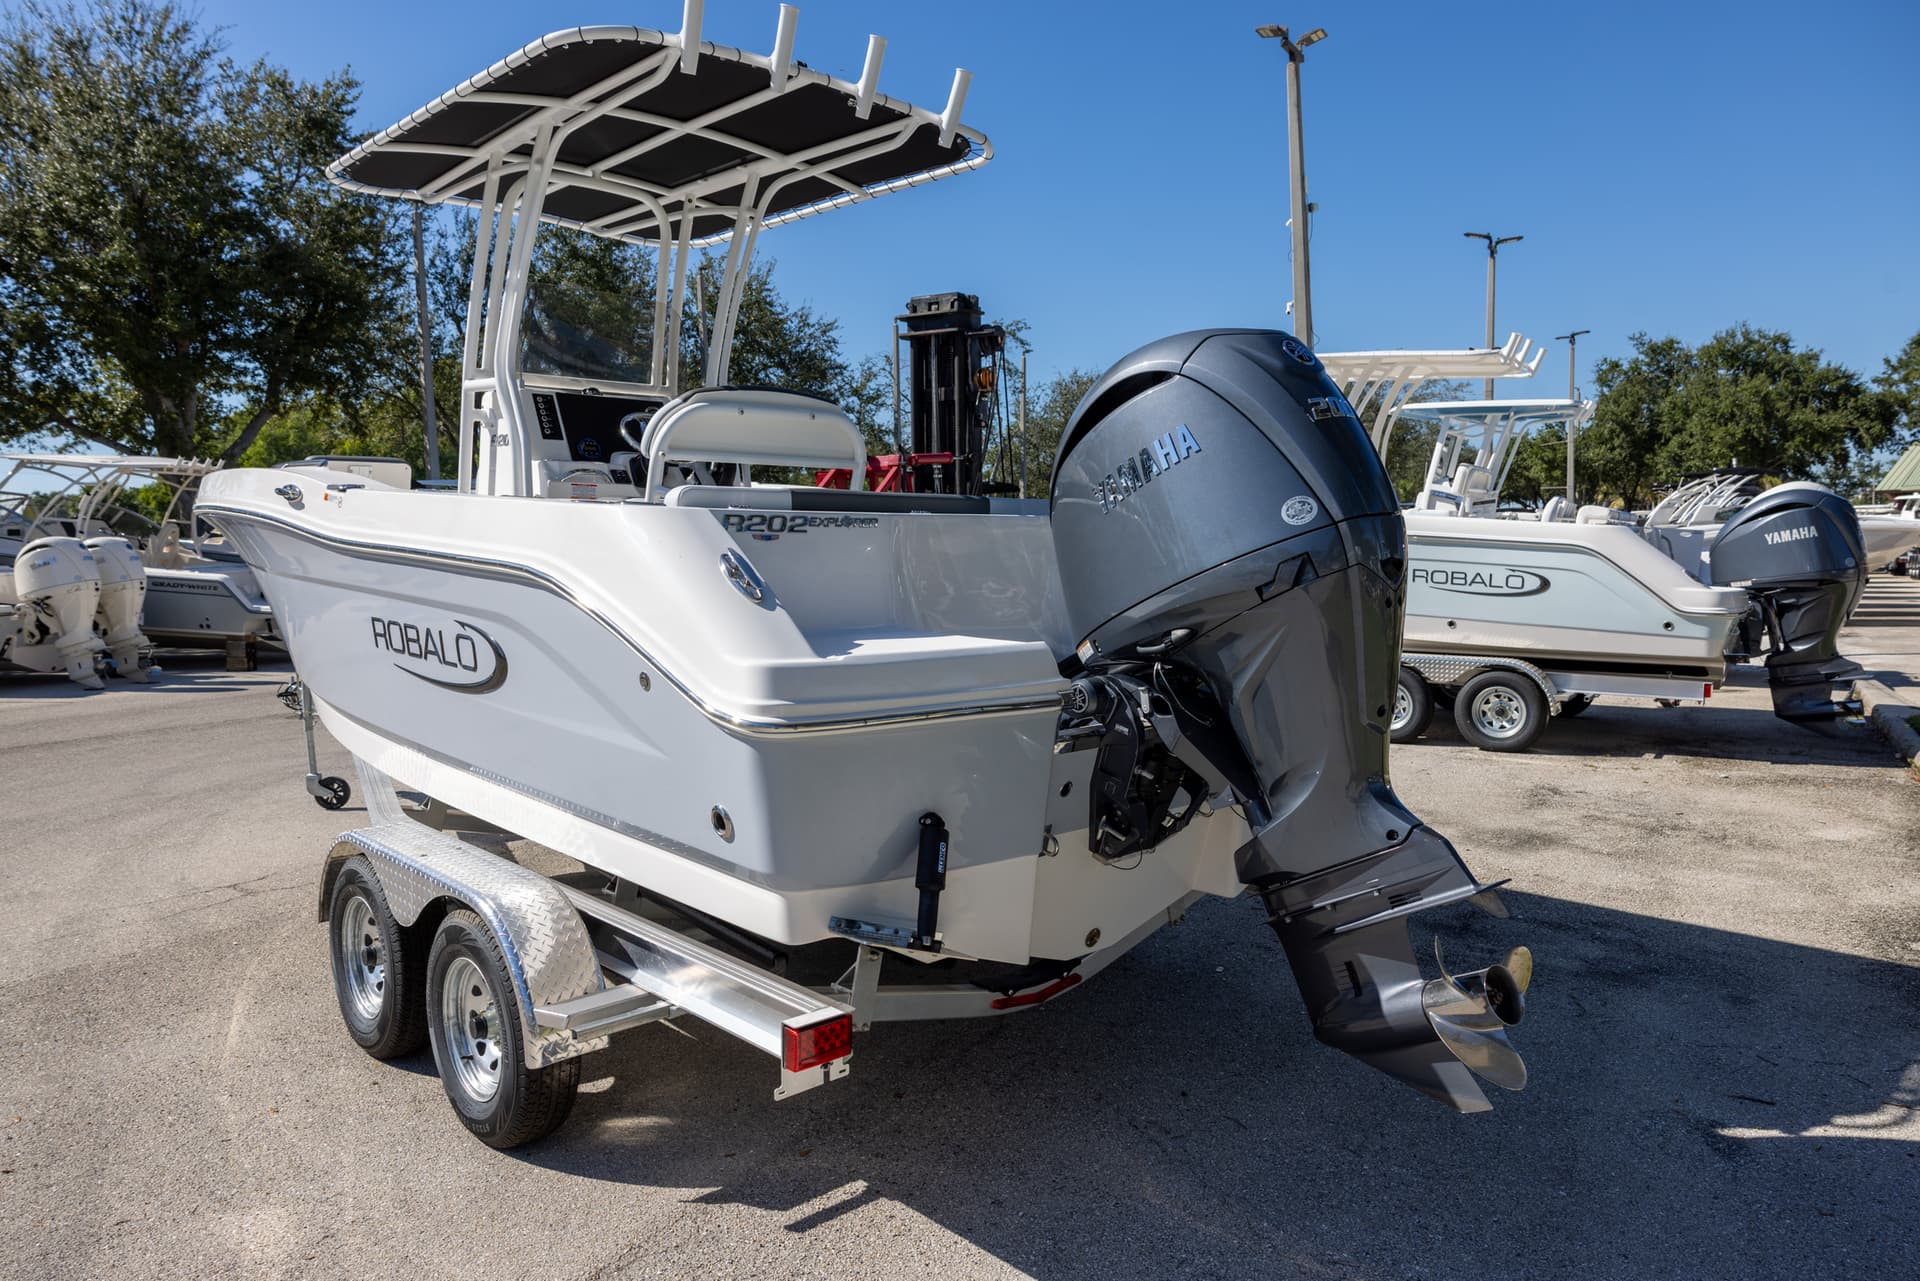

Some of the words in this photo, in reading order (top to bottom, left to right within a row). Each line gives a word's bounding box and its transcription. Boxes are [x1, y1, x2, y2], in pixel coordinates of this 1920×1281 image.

[1092, 423, 1202, 515] YAMAHA
[723, 513, 808, 533] R202
[1764, 525, 1818, 545] YAMAHA
[1411, 567, 1525, 591] ROBALO
[370, 616, 478, 673] ROBALO
